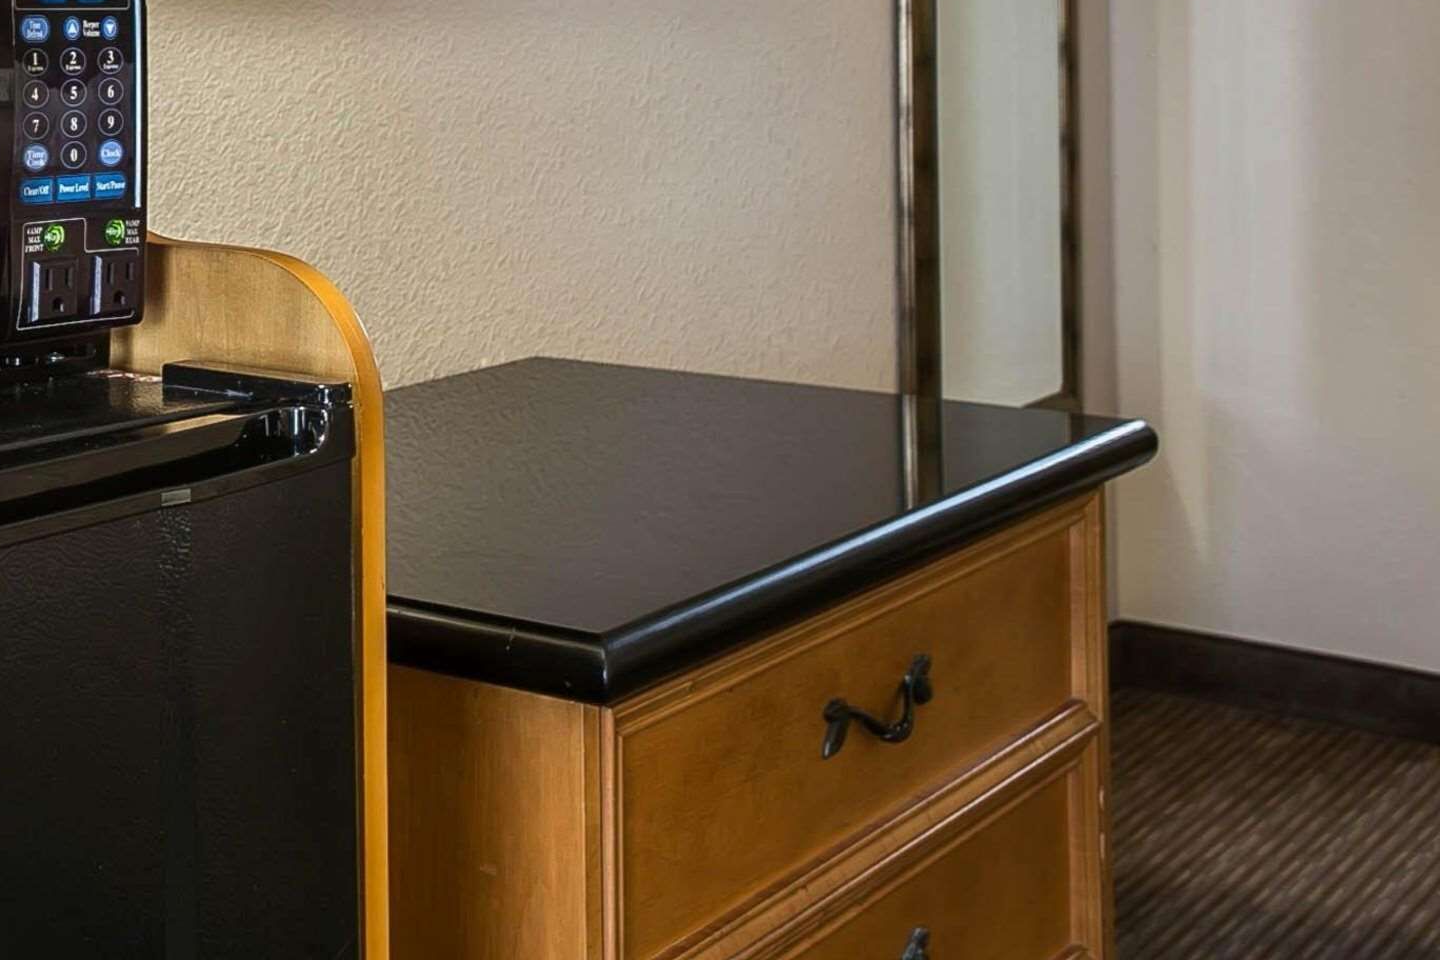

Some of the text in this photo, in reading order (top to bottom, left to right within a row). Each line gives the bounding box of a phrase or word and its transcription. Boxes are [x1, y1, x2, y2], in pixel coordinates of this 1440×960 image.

[33, 52, 38, 66] 1
[69, 51, 77, 65] 2
[107, 50, 115, 64] 3
[31, 87, 39, 101] 4
[69, 85, 78, 100] 5
[107, 84, 115, 99] 6
[32, 119, 40, 134] 7
[70, 117, 78, 131] 8
[107, 115, 115, 129] 9
[70, 148, 78, 162] 0
